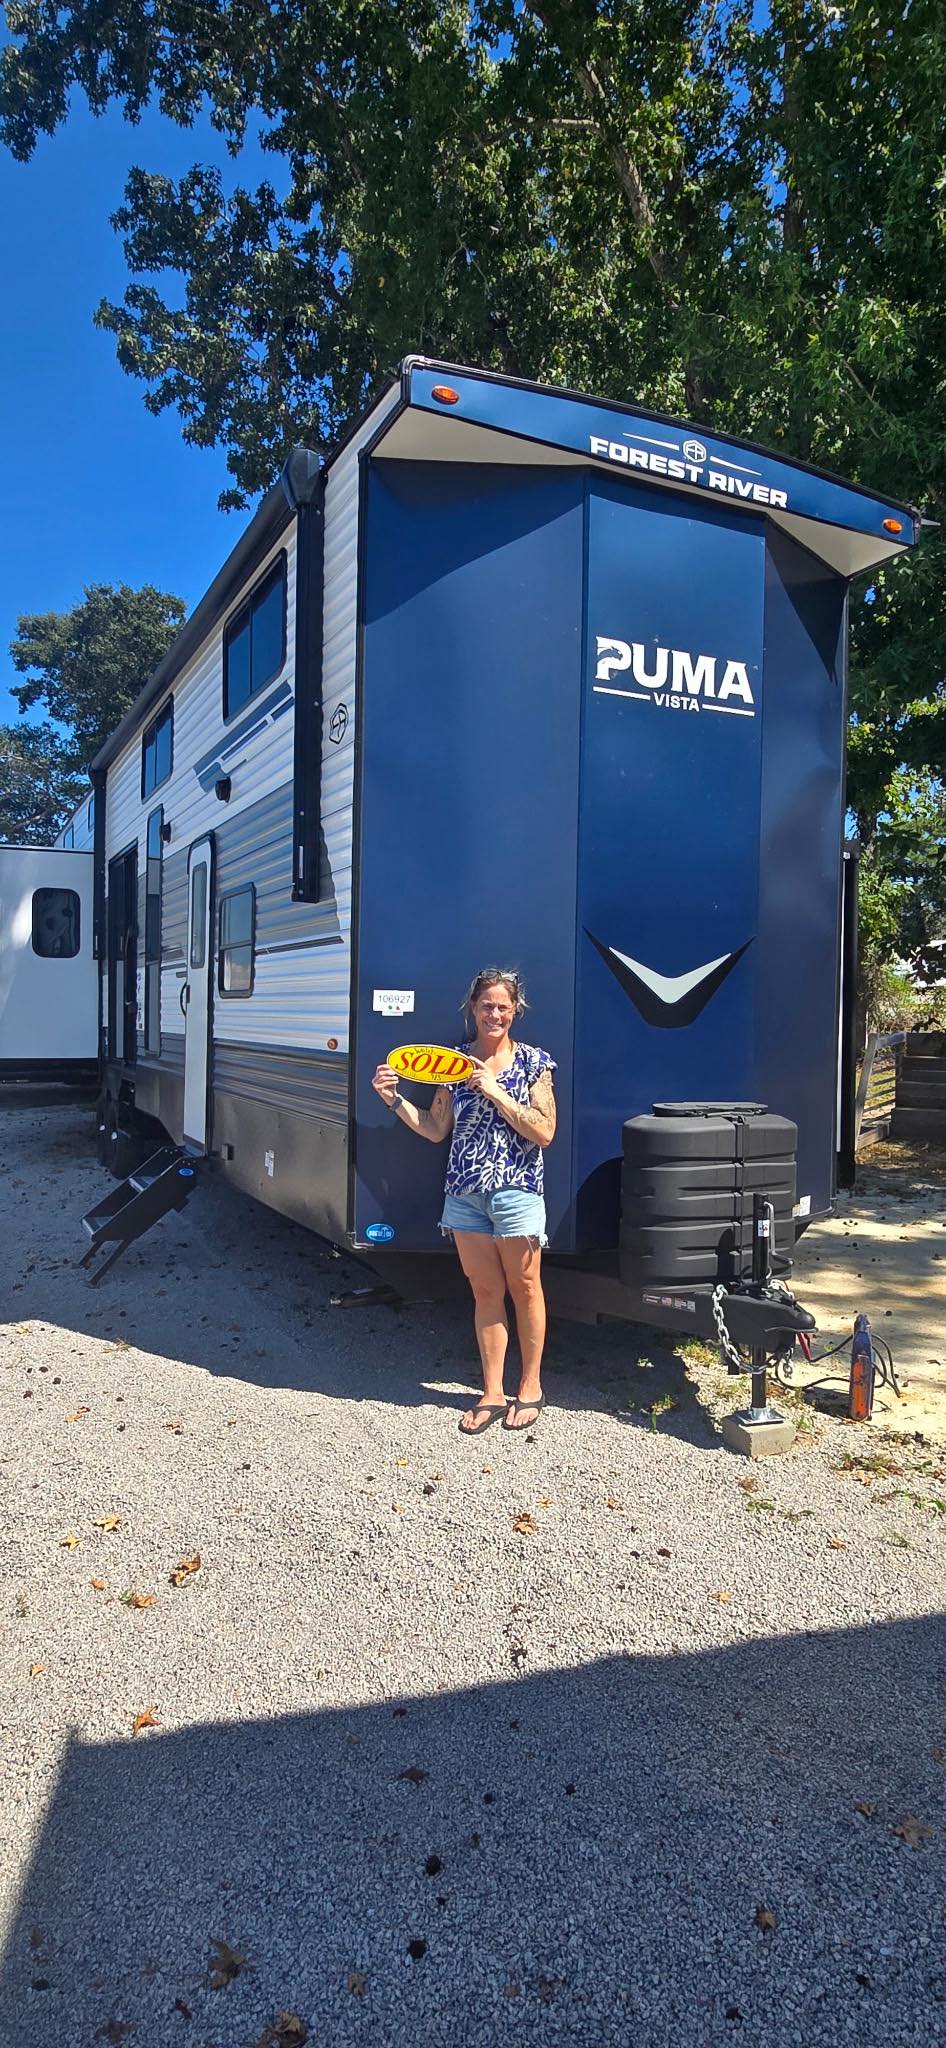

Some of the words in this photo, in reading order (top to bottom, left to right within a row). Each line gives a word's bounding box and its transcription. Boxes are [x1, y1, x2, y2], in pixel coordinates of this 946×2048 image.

[589, 435, 704, 483] FOREST
[708, 470, 788, 509] RIVER
[595, 636, 755, 704] PUMA
[653, 692, 700, 712] VISTA
[378, 994, 411, 1004] 106927
[395, 1051, 469, 1076] SOLD
